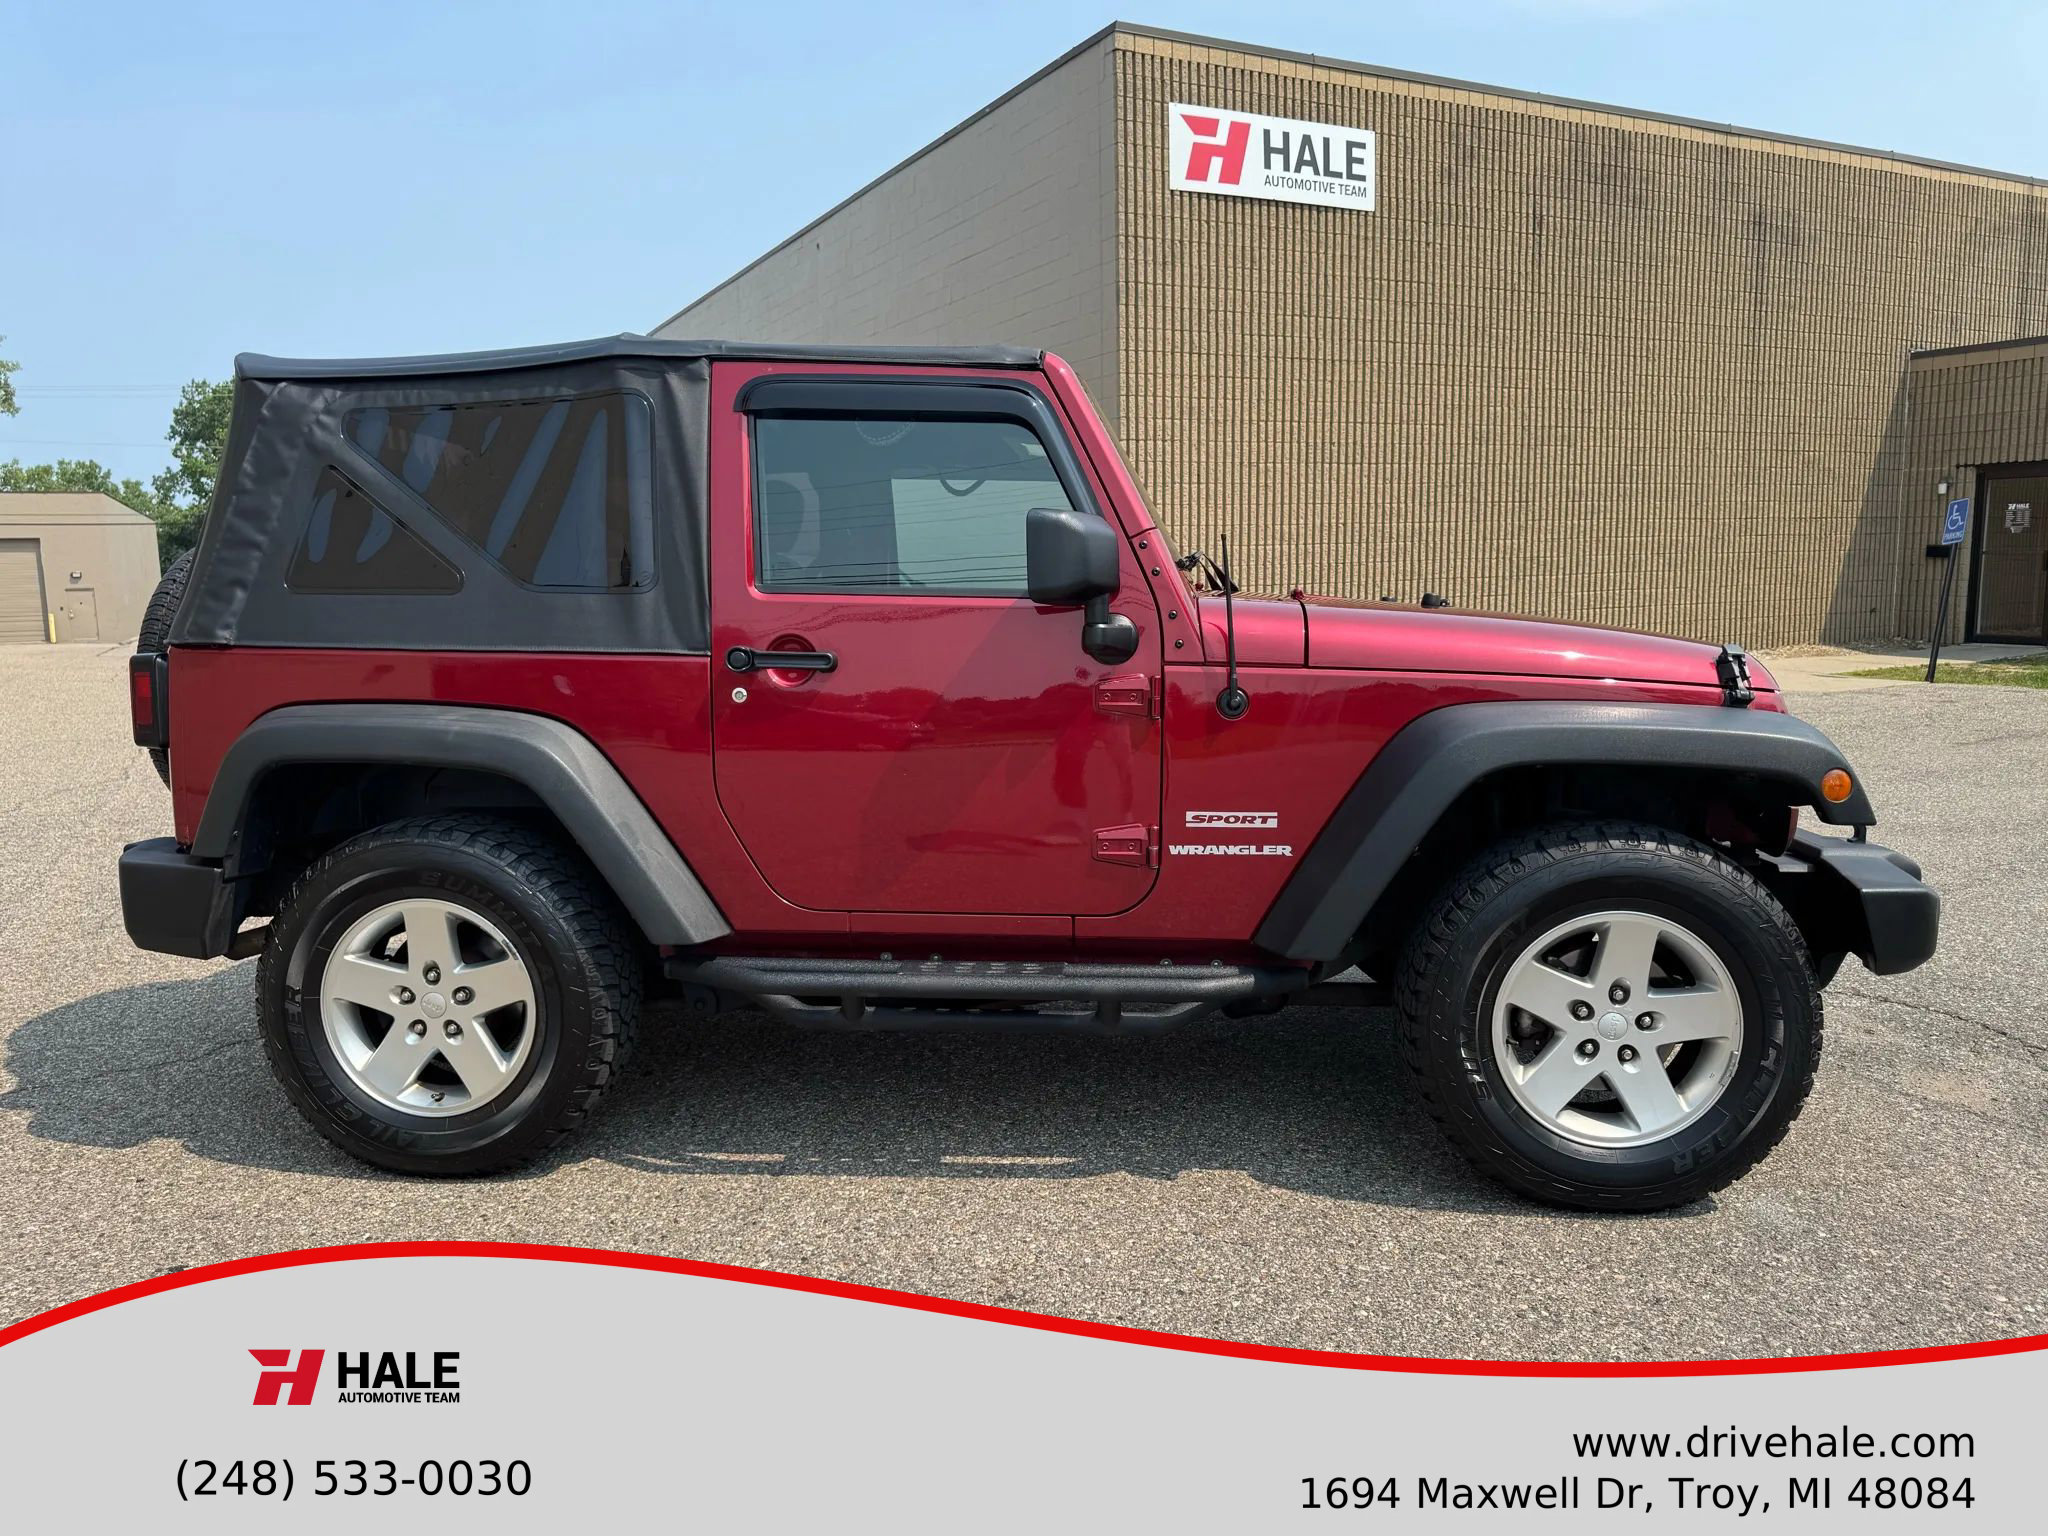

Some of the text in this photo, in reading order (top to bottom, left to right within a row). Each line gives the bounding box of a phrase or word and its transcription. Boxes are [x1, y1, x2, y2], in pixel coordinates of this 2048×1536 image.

[1263, 128, 1367, 182] HALE
[1264, 174, 1367, 198] AUTOMOTIVE TEAM
[1187, 813, 1277, 826] SPORT
[1168, 844, 1293, 857] WRANGLER
